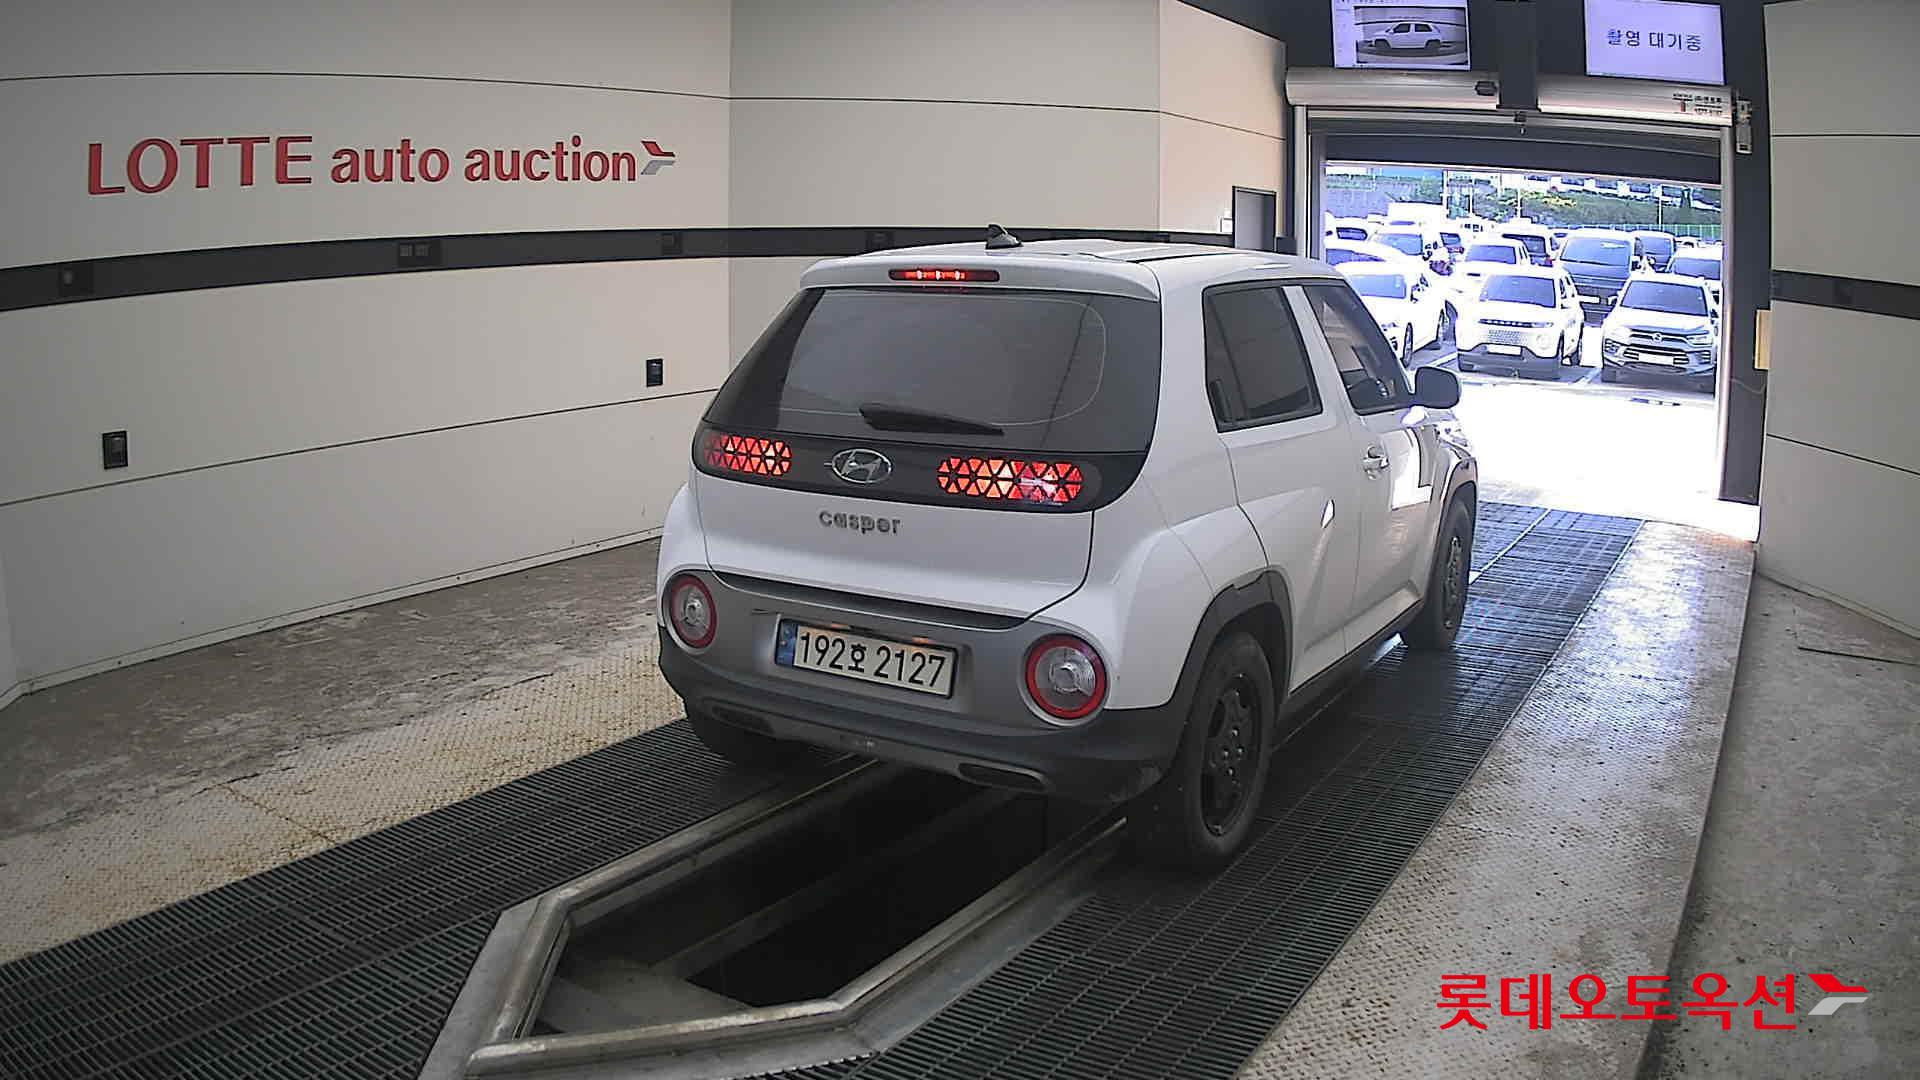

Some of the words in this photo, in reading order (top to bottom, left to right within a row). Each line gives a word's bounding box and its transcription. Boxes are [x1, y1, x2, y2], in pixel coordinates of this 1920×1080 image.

[1648, 32, 1702, 52] 대기중
[88, 135, 312, 195] LOTTE
[330, 138, 451, 184] auto
[464, 135, 637, 184] auction
[819, 510, 901, 535] casper
[800, 631, 867, 673] 192호
[873, 645, 946, 687] 2127
